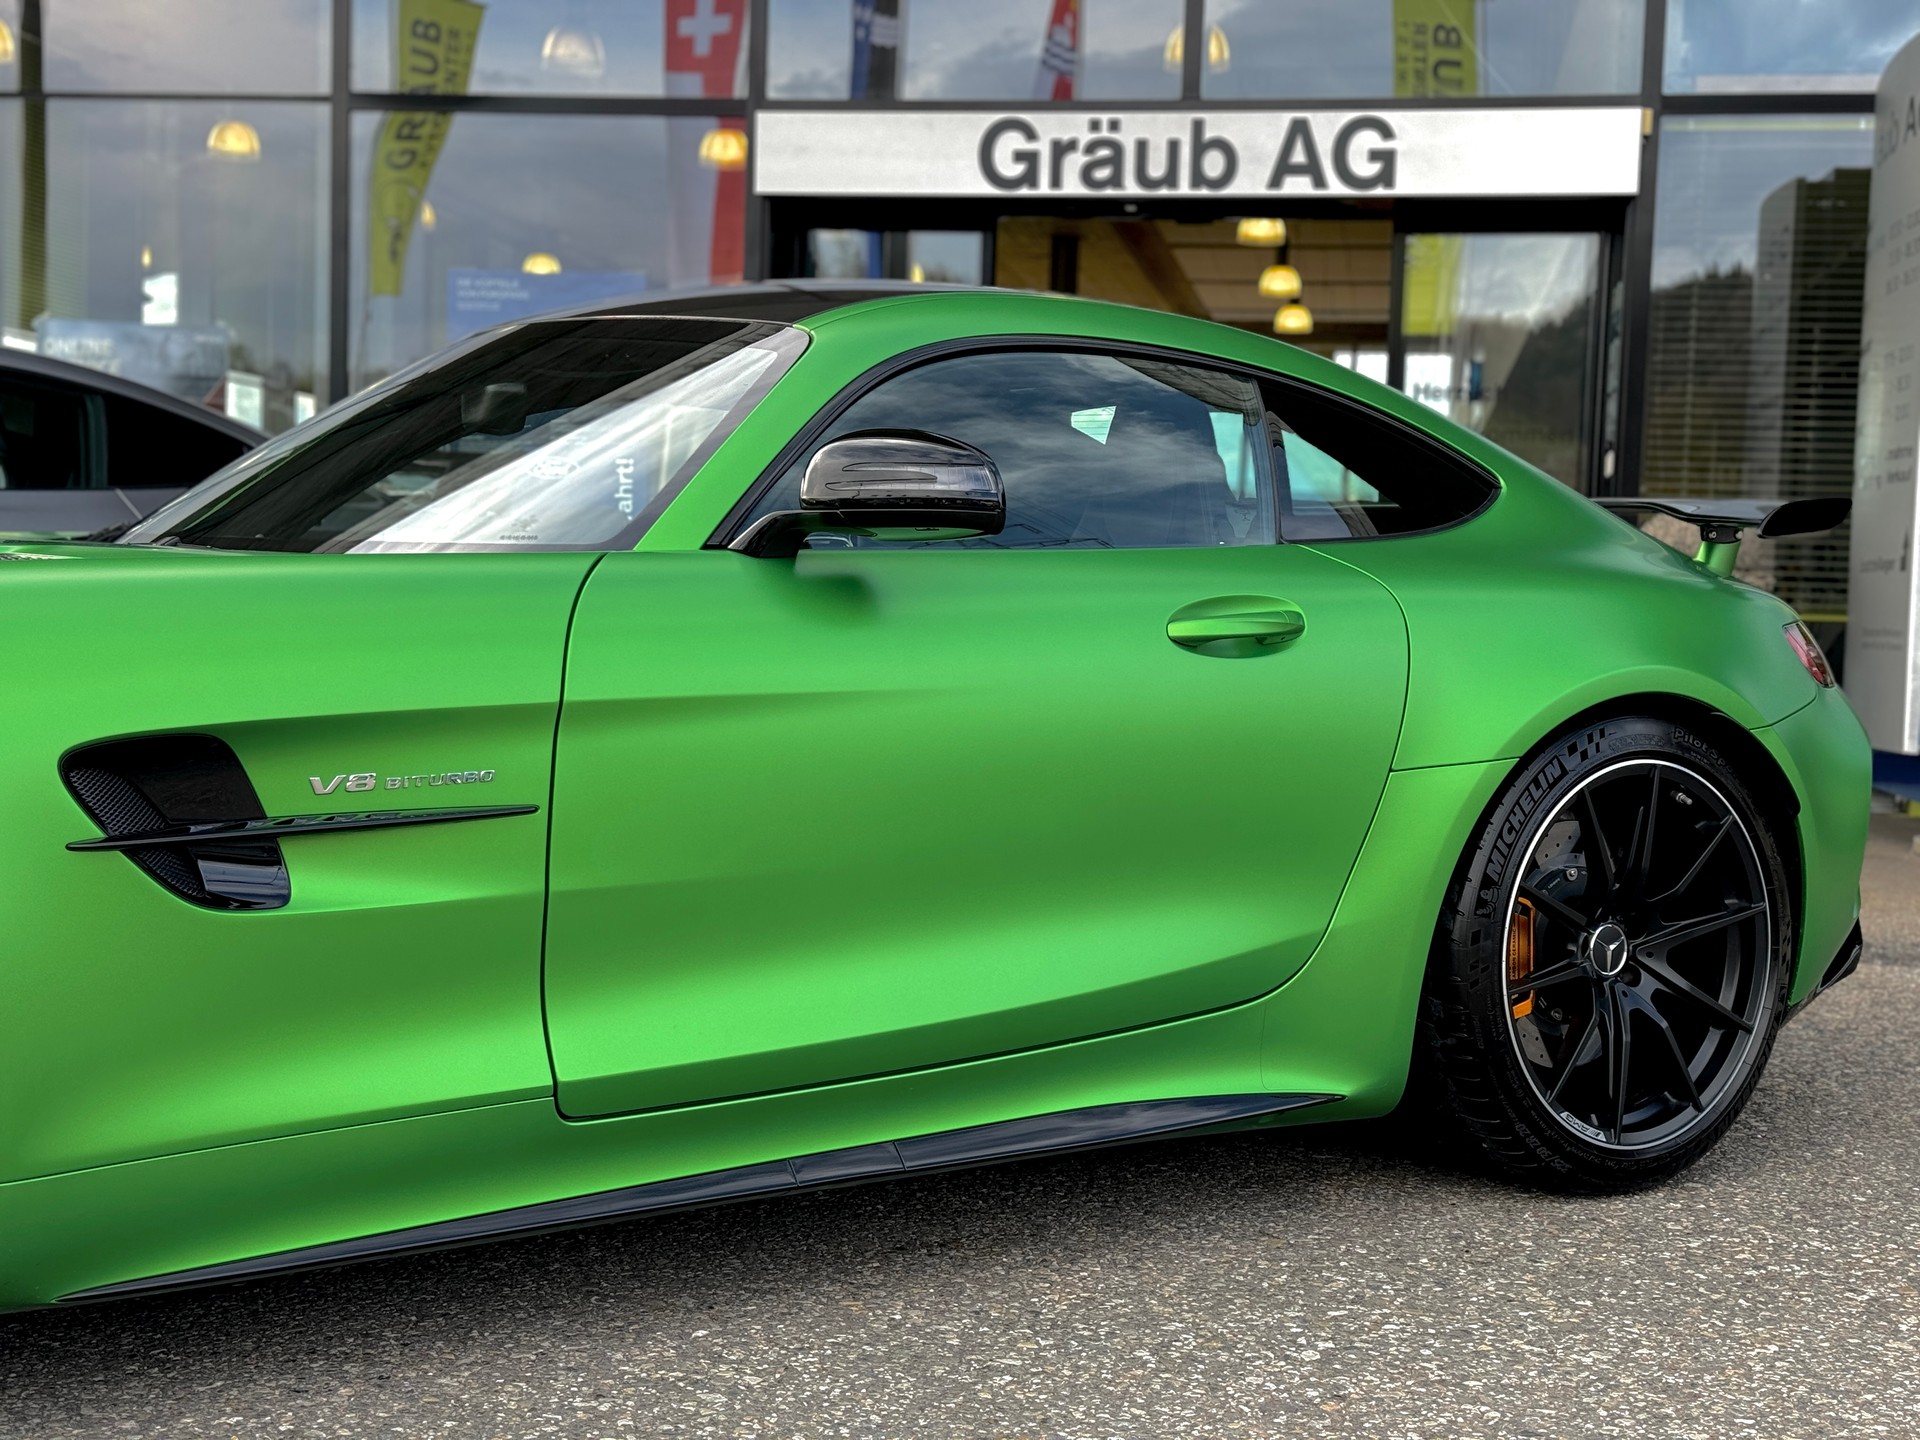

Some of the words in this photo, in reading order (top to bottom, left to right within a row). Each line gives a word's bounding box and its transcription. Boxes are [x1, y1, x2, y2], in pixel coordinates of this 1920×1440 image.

[979, 117, 1238, 191] Gräub
[1267, 117, 1397, 191] AG
[614, 458, 634, 520] ahrt!
[1674, 727, 1708, 752] Pilot
[309, 773, 377, 796] V8
[383, 769, 496, 790] BITURBO
[1486, 756, 1564, 883] MICHELIN
